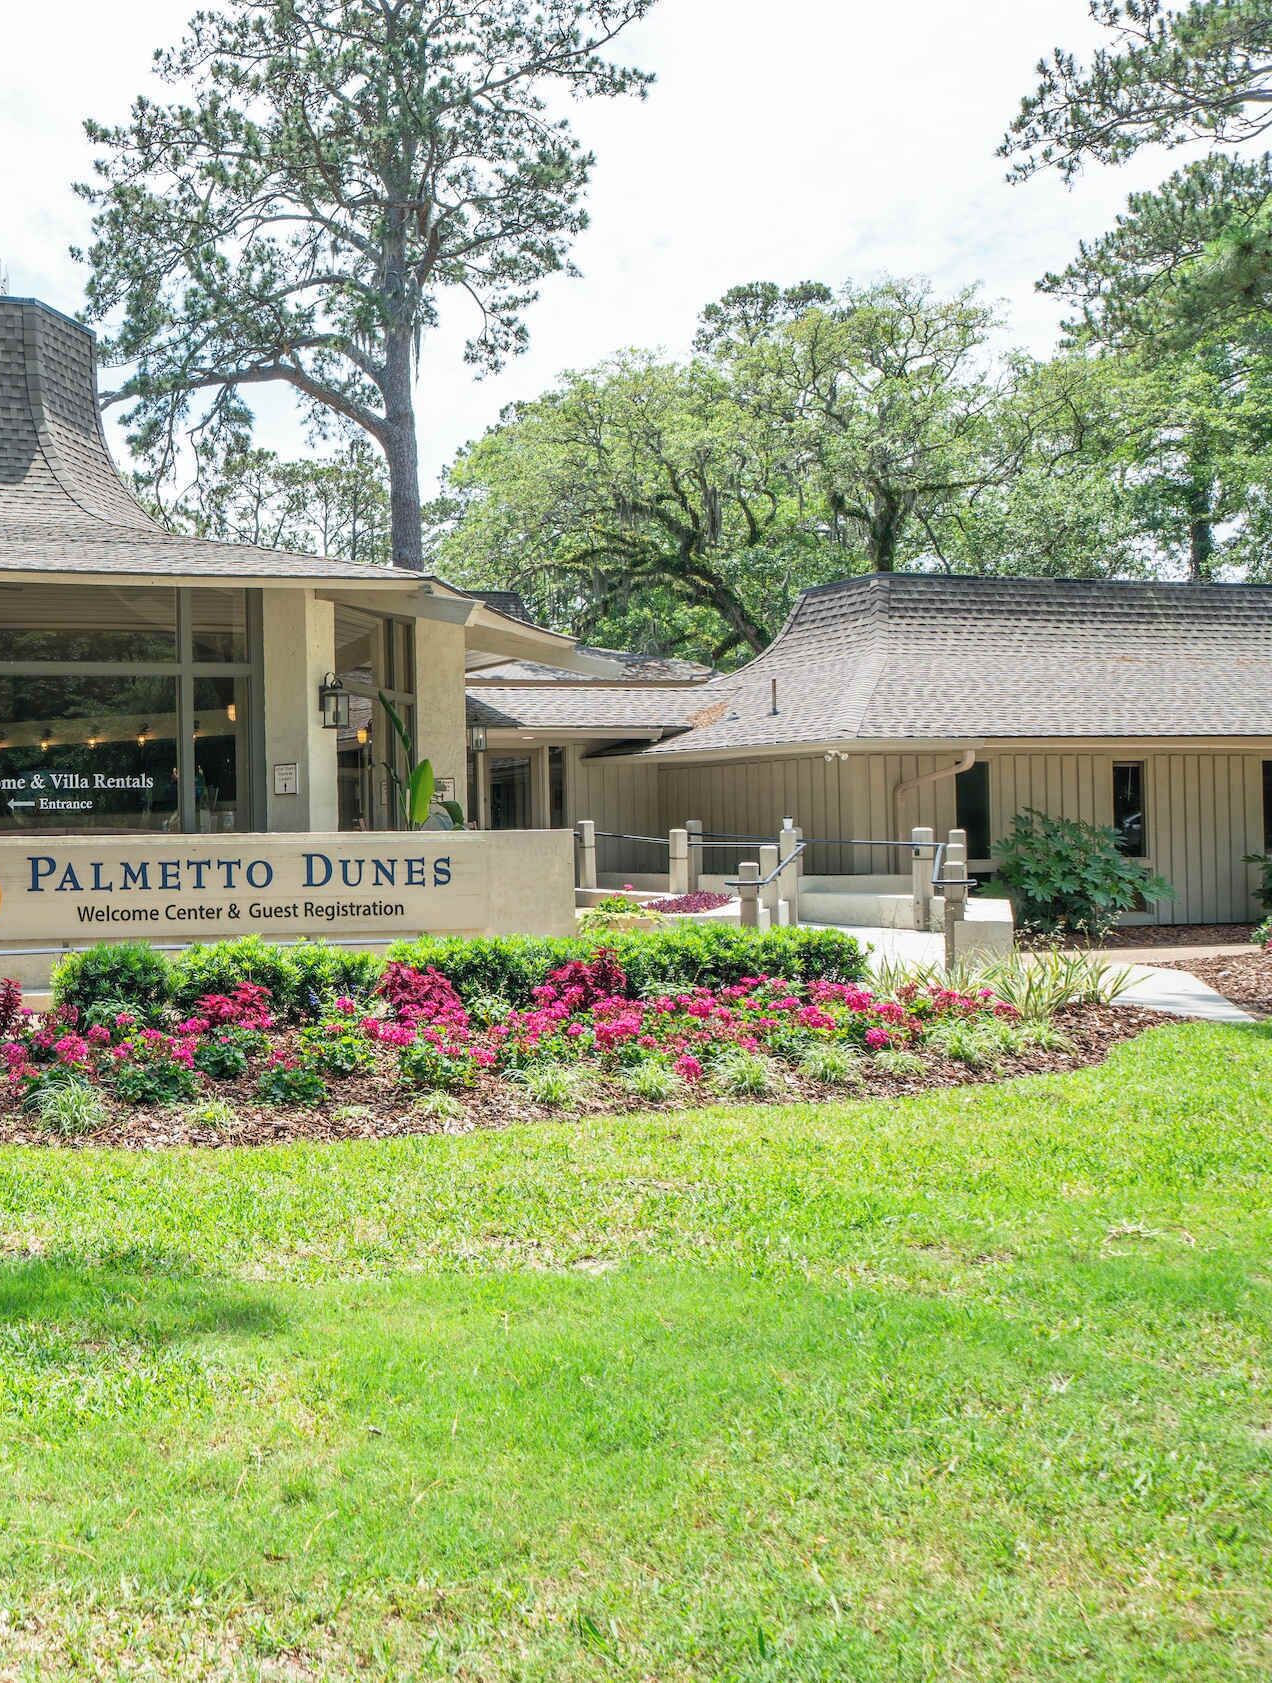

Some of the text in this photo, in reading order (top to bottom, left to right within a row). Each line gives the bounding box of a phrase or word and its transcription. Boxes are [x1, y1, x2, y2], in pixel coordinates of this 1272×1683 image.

[30, 774, 46, 789] &
[49, 773, 89, 789] Villa
[93, 772, 154, 789] Rentals
[39, 797, 94, 810] Entrance
[26, 853, 452, 892] PALMETTO DUNES
[77, 901, 405, 922] Welcome Center & Guest Registration
